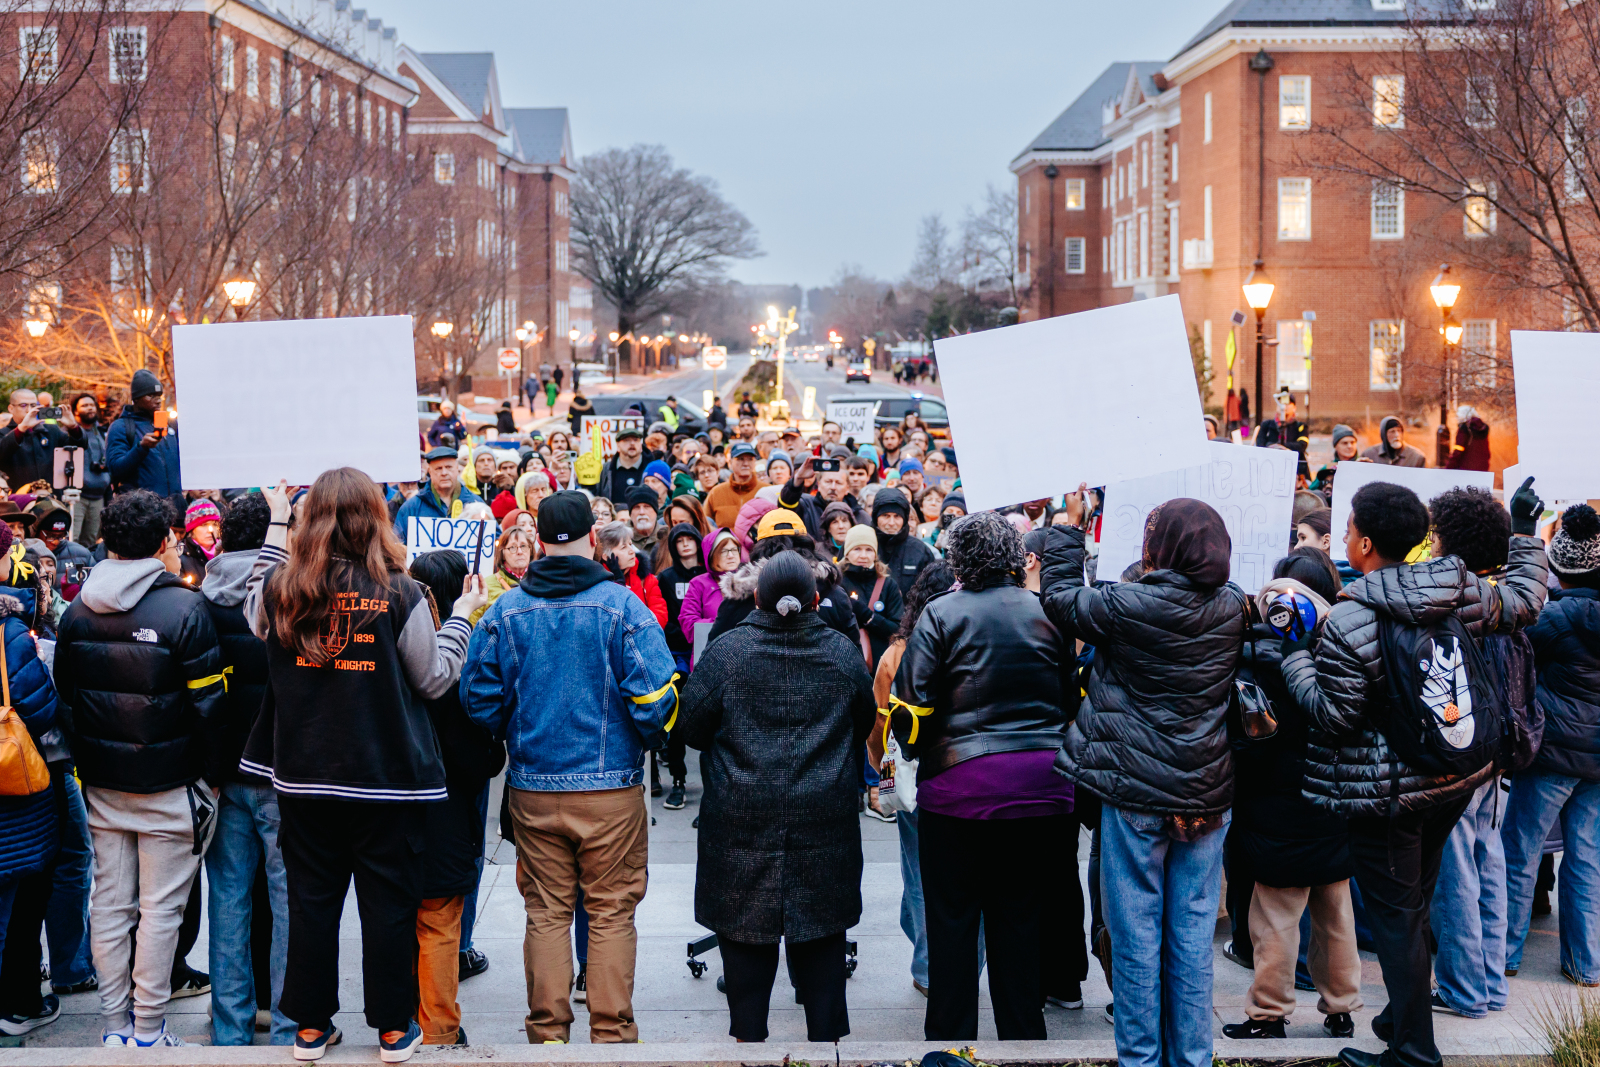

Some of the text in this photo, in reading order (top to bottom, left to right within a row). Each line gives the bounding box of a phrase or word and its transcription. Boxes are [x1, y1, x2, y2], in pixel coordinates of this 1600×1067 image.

[835, 407, 867, 417] ICE OUT
[841, 421, 865, 432] NOW
[332, 598, 389, 612] OLLEGE
[353, 633, 375, 643] 1839
[334, 659, 376, 671] KNIGHTS
